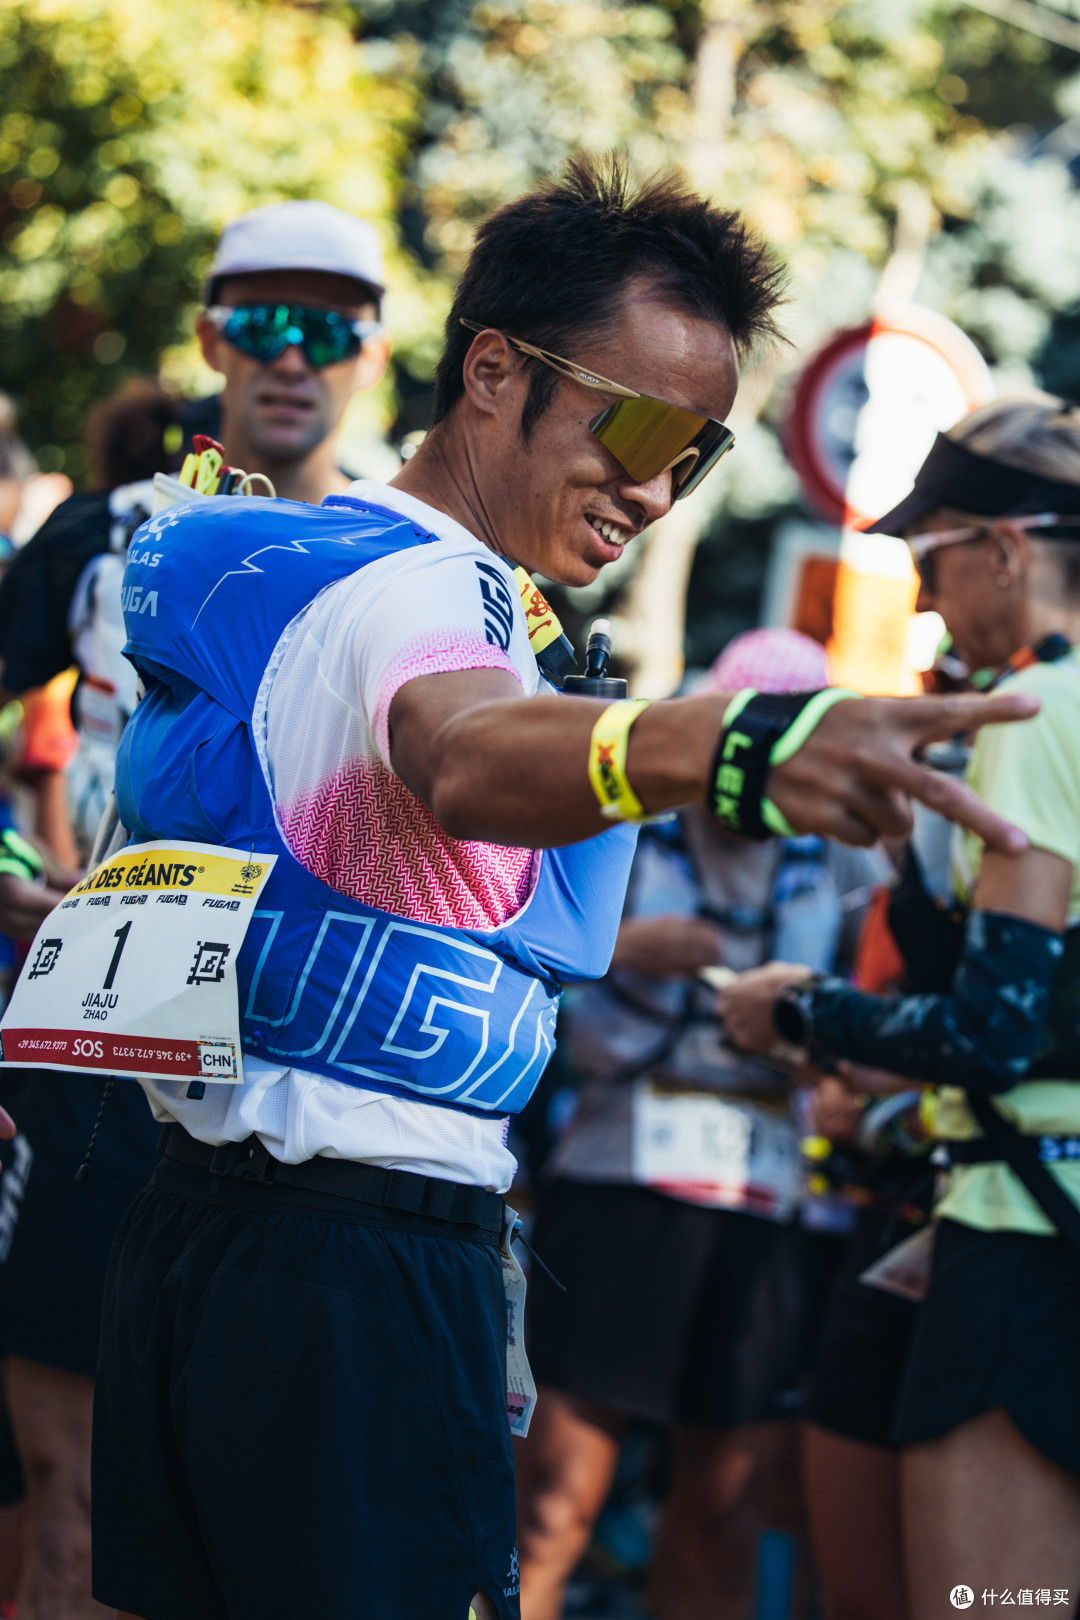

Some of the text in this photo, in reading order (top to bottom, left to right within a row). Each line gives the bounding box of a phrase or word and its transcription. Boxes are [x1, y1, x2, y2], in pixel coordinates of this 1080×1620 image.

[580, 372, 600, 384] RUDY
[121, 586, 159, 617] UGA
[95, 867, 126, 889] DES
[86, 896, 105, 905] FUGA
[156, 895, 179, 904] FUGA
[202, 899, 231, 910] FUGA
[103, 921, 133, 989] 1
[82, 993, 118, 1008] JIAJU
[83, 1010, 108, 1021] ZHAO
[72, 1039, 104, 1058] SOS
[203, 1054, 231, 1067] CHN
